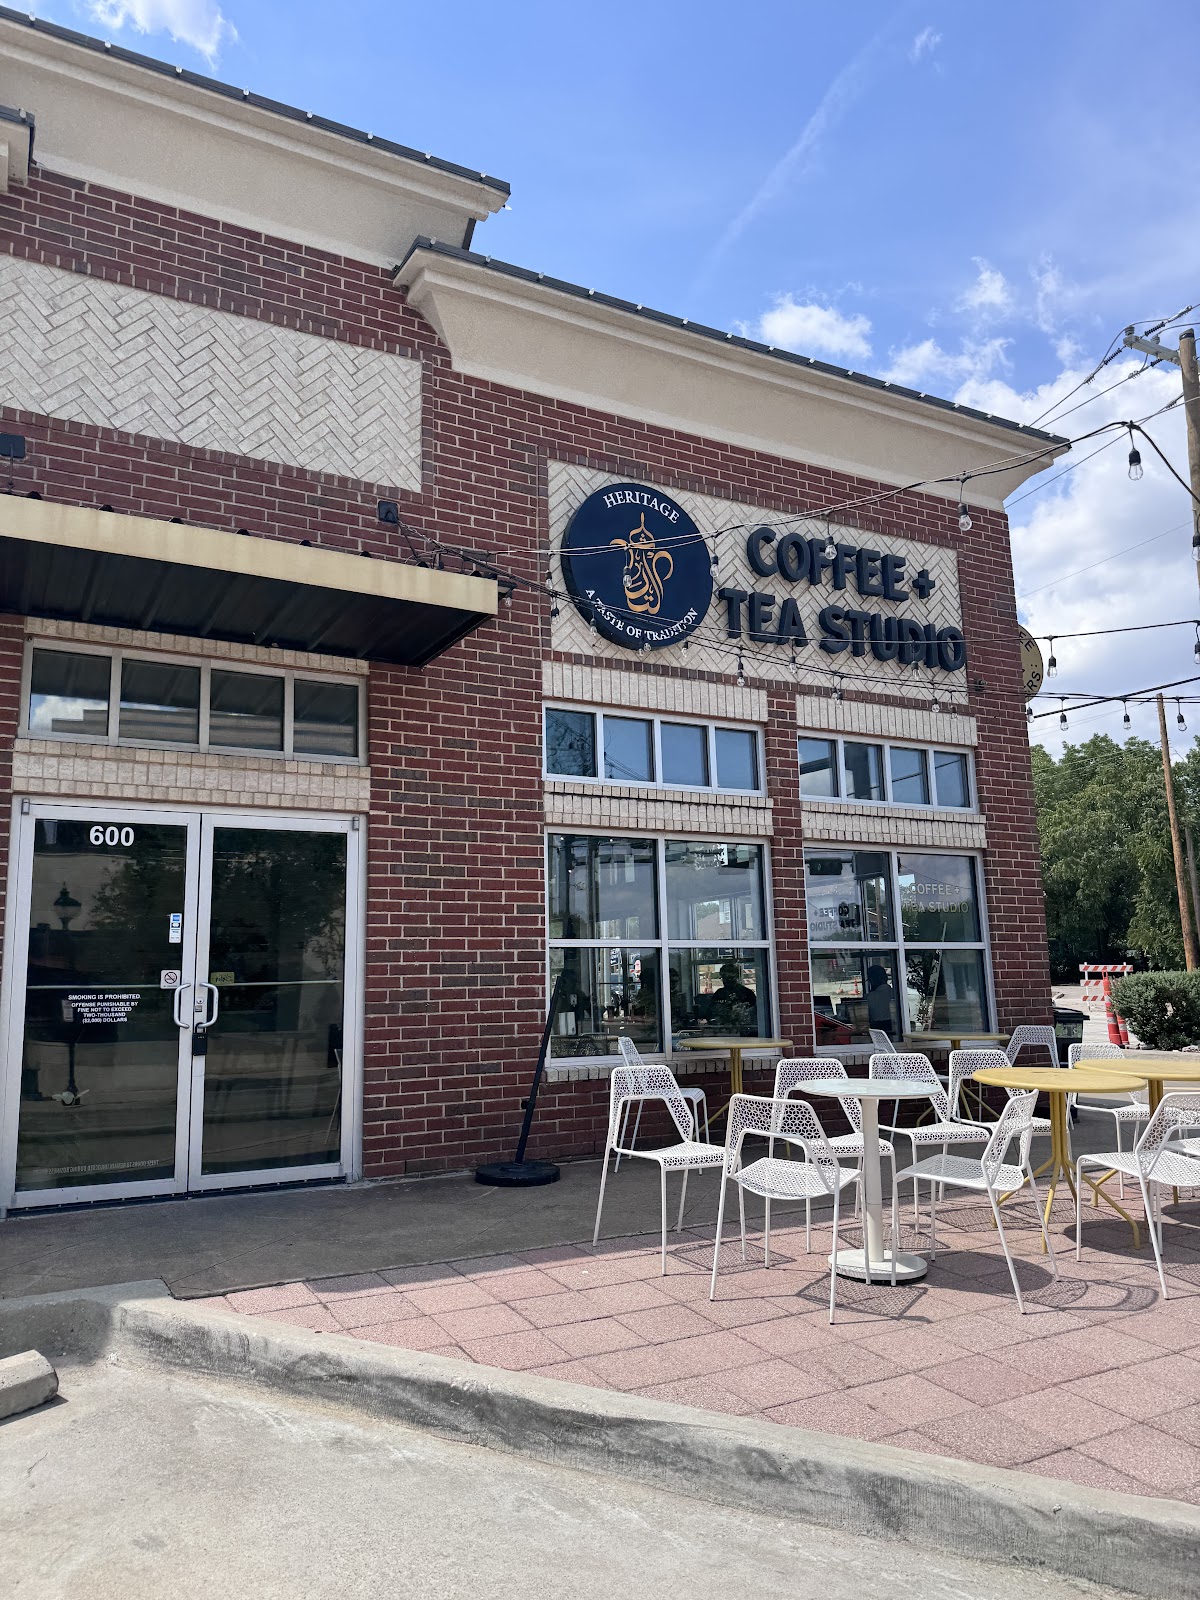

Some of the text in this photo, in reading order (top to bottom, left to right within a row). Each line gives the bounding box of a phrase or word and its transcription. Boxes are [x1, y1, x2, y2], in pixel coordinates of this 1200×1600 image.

[603, 490, 680, 524] HERITAGE
[747, 526, 909, 603] COFFEE
[585, 589, 699, 641] A TASTE OF TRADITION
[718, 587, 966, 673] TEA STUDIO
[89, 825, 135, 847] 600
[909, 883, 952, 895] COFFEE
[903, 901, 969, 913] TEA STUDIO
